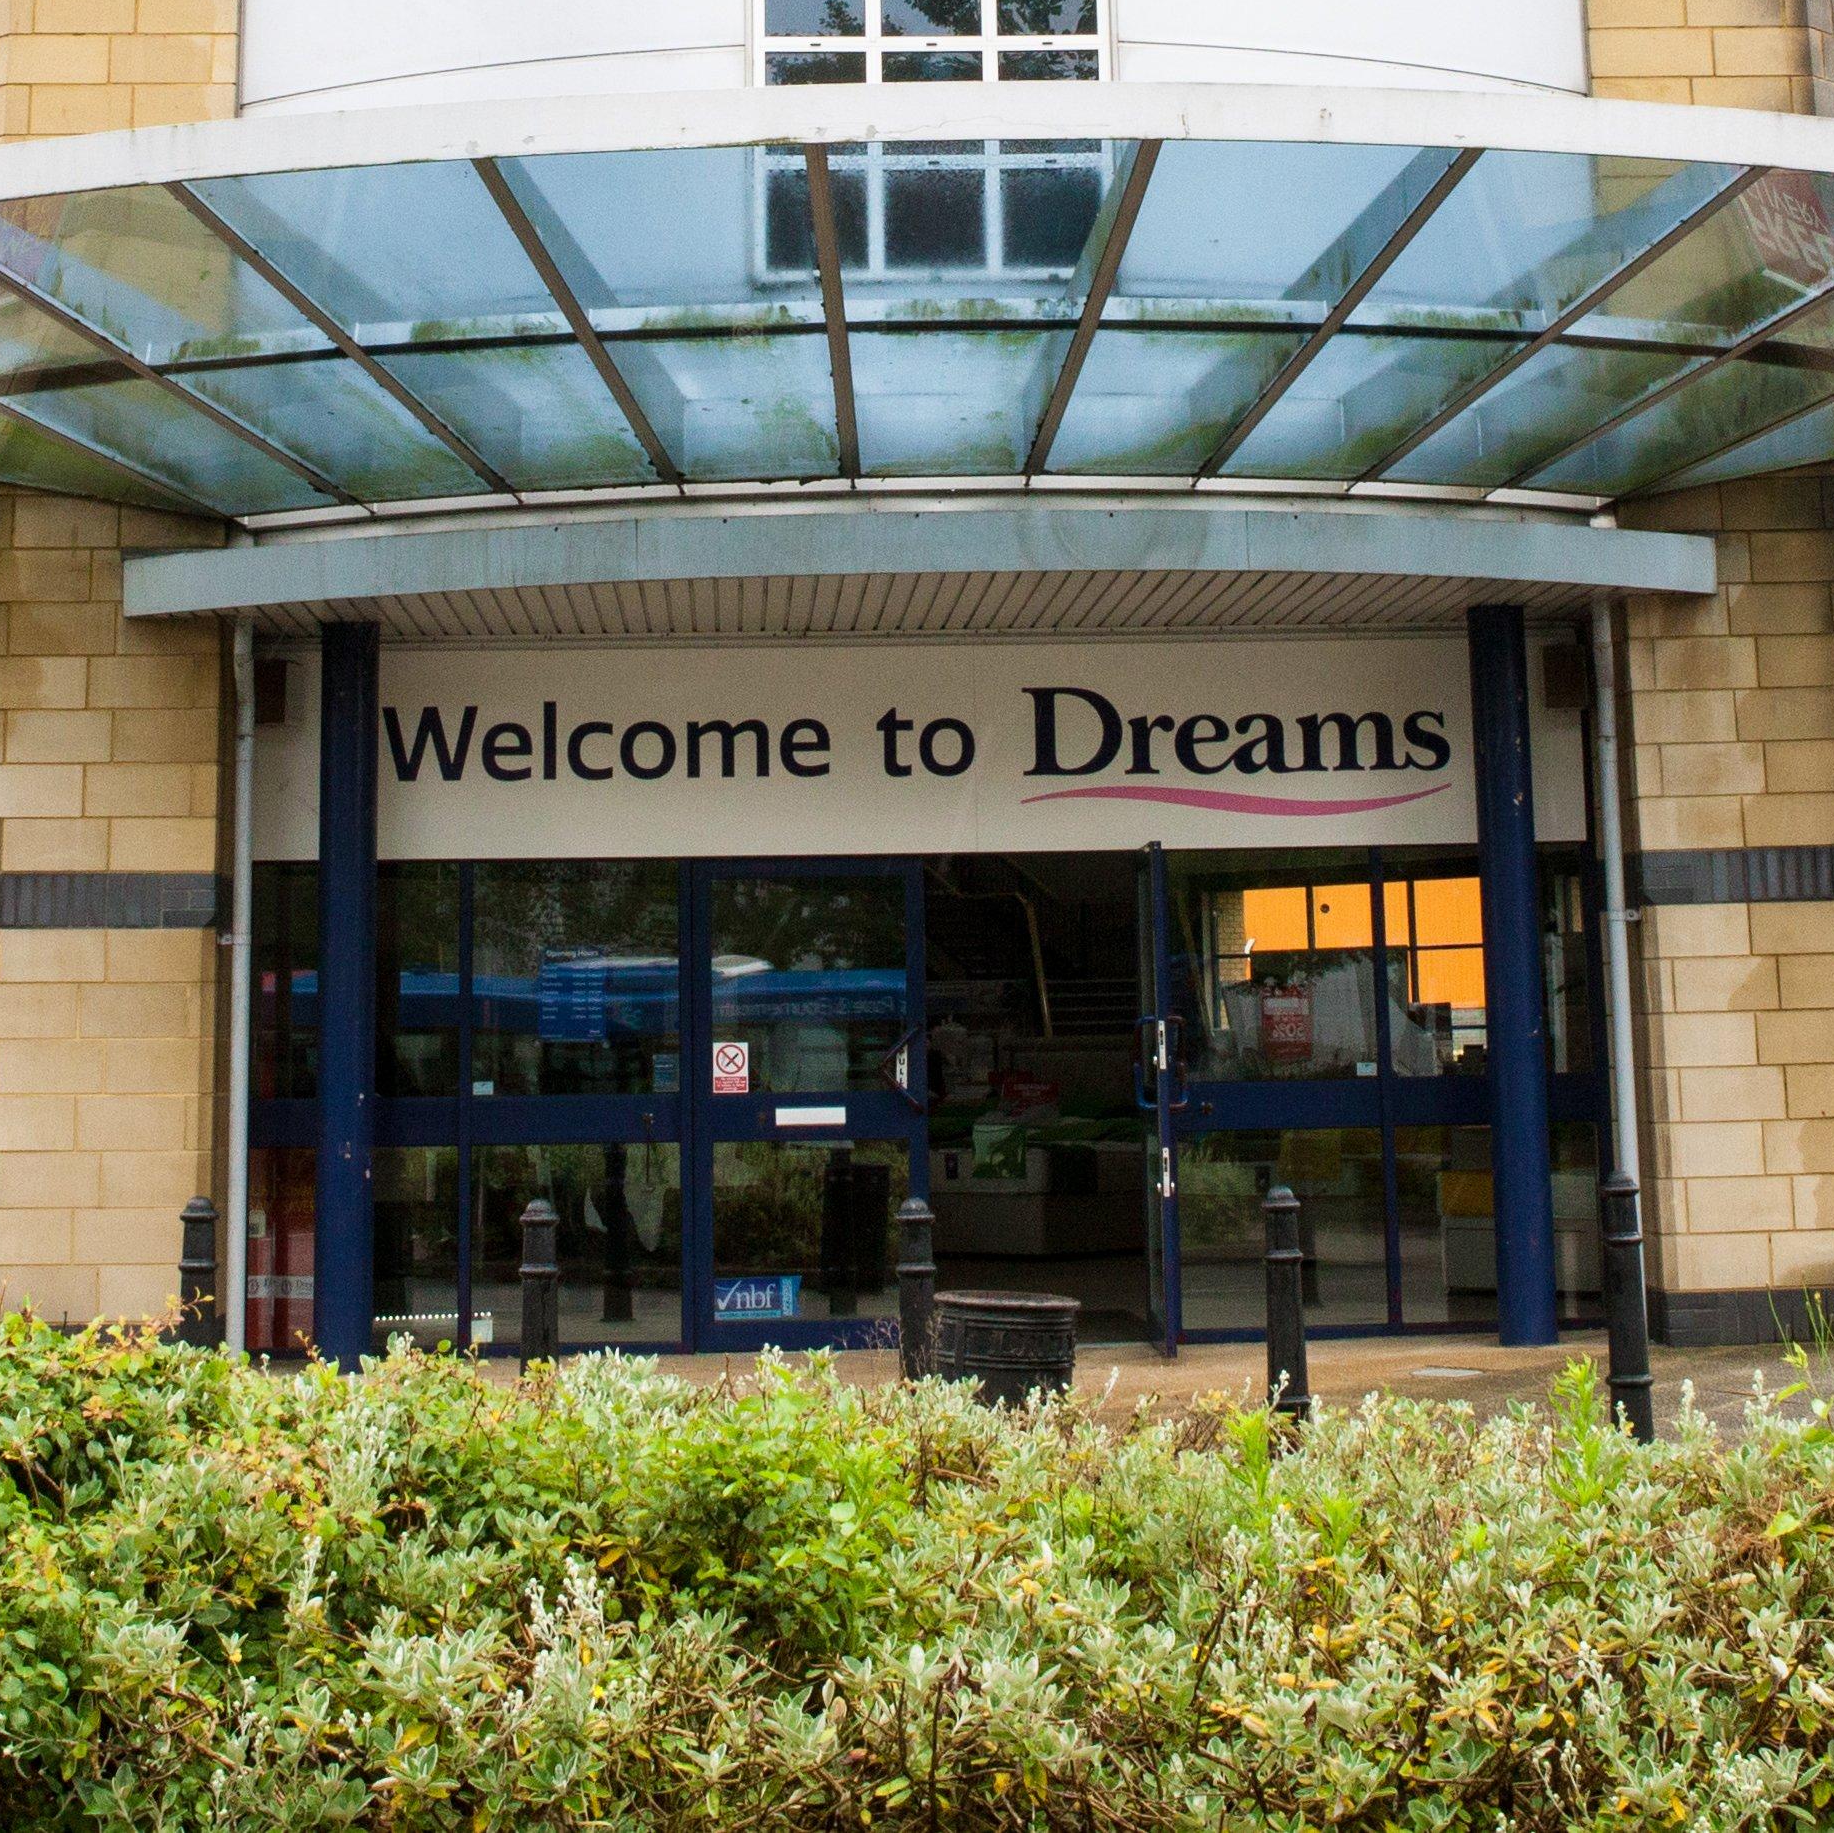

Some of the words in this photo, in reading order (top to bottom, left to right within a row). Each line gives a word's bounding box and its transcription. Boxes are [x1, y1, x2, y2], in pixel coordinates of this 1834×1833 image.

[383, 700, 831, 783] Welcome
[877, 707, 976, 777] to
[1021, 686, 1451, 777] Dreams
[736, 1283, 776, 1309] nbf
